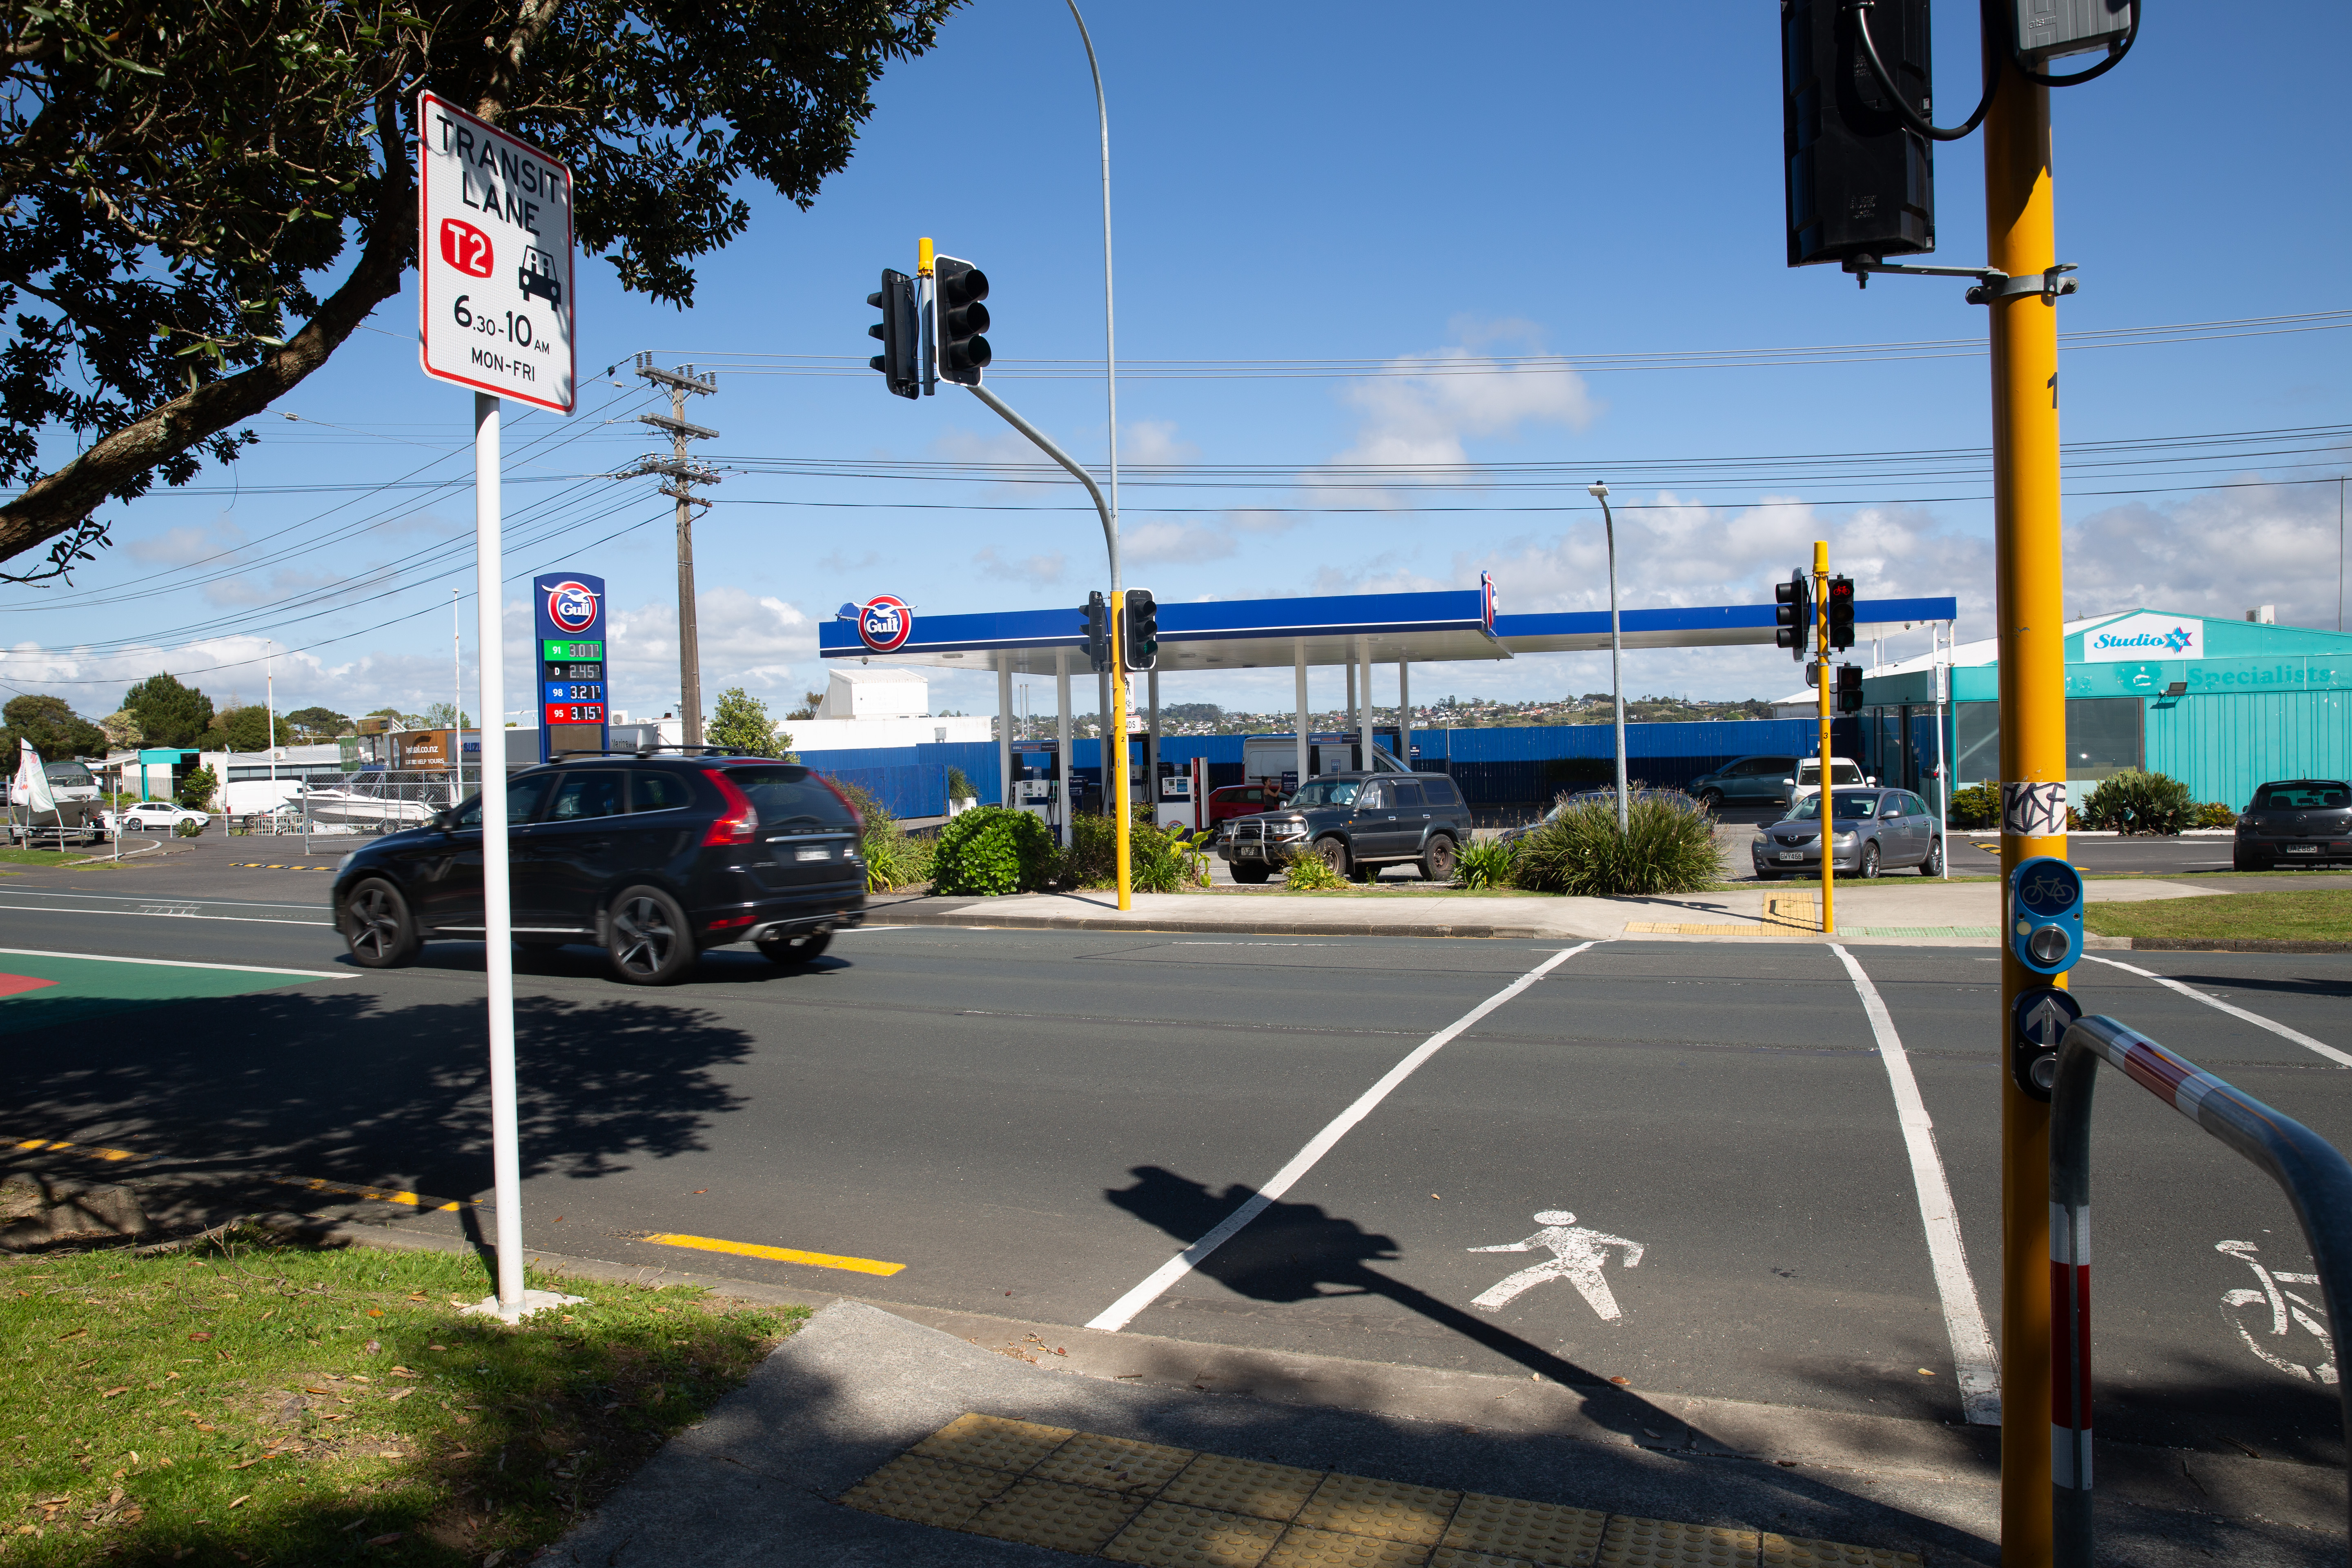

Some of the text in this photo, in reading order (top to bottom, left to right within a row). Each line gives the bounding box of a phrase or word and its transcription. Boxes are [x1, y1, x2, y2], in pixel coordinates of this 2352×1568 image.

[437, 114, 559, 204] TRANSIT
[462, 171, 540, 237] LANE
[448, 223, 486, 274] T2
[472, 347, 535, 382] MON-FRI
[2047, 372, 2057, 409] 1
[559, 602, 590, 616] Gull
[866, 617, 899, 633] Gull
[2094, 633, 2185, 649] Studio 246
[552, 646, 561, 654] 91
[555, 667, 560, 675] D
[2188, 665, 2331, 687] Specialists
[553, 688, 563, 697] 98
[611, 739, 628, 748] Marine
